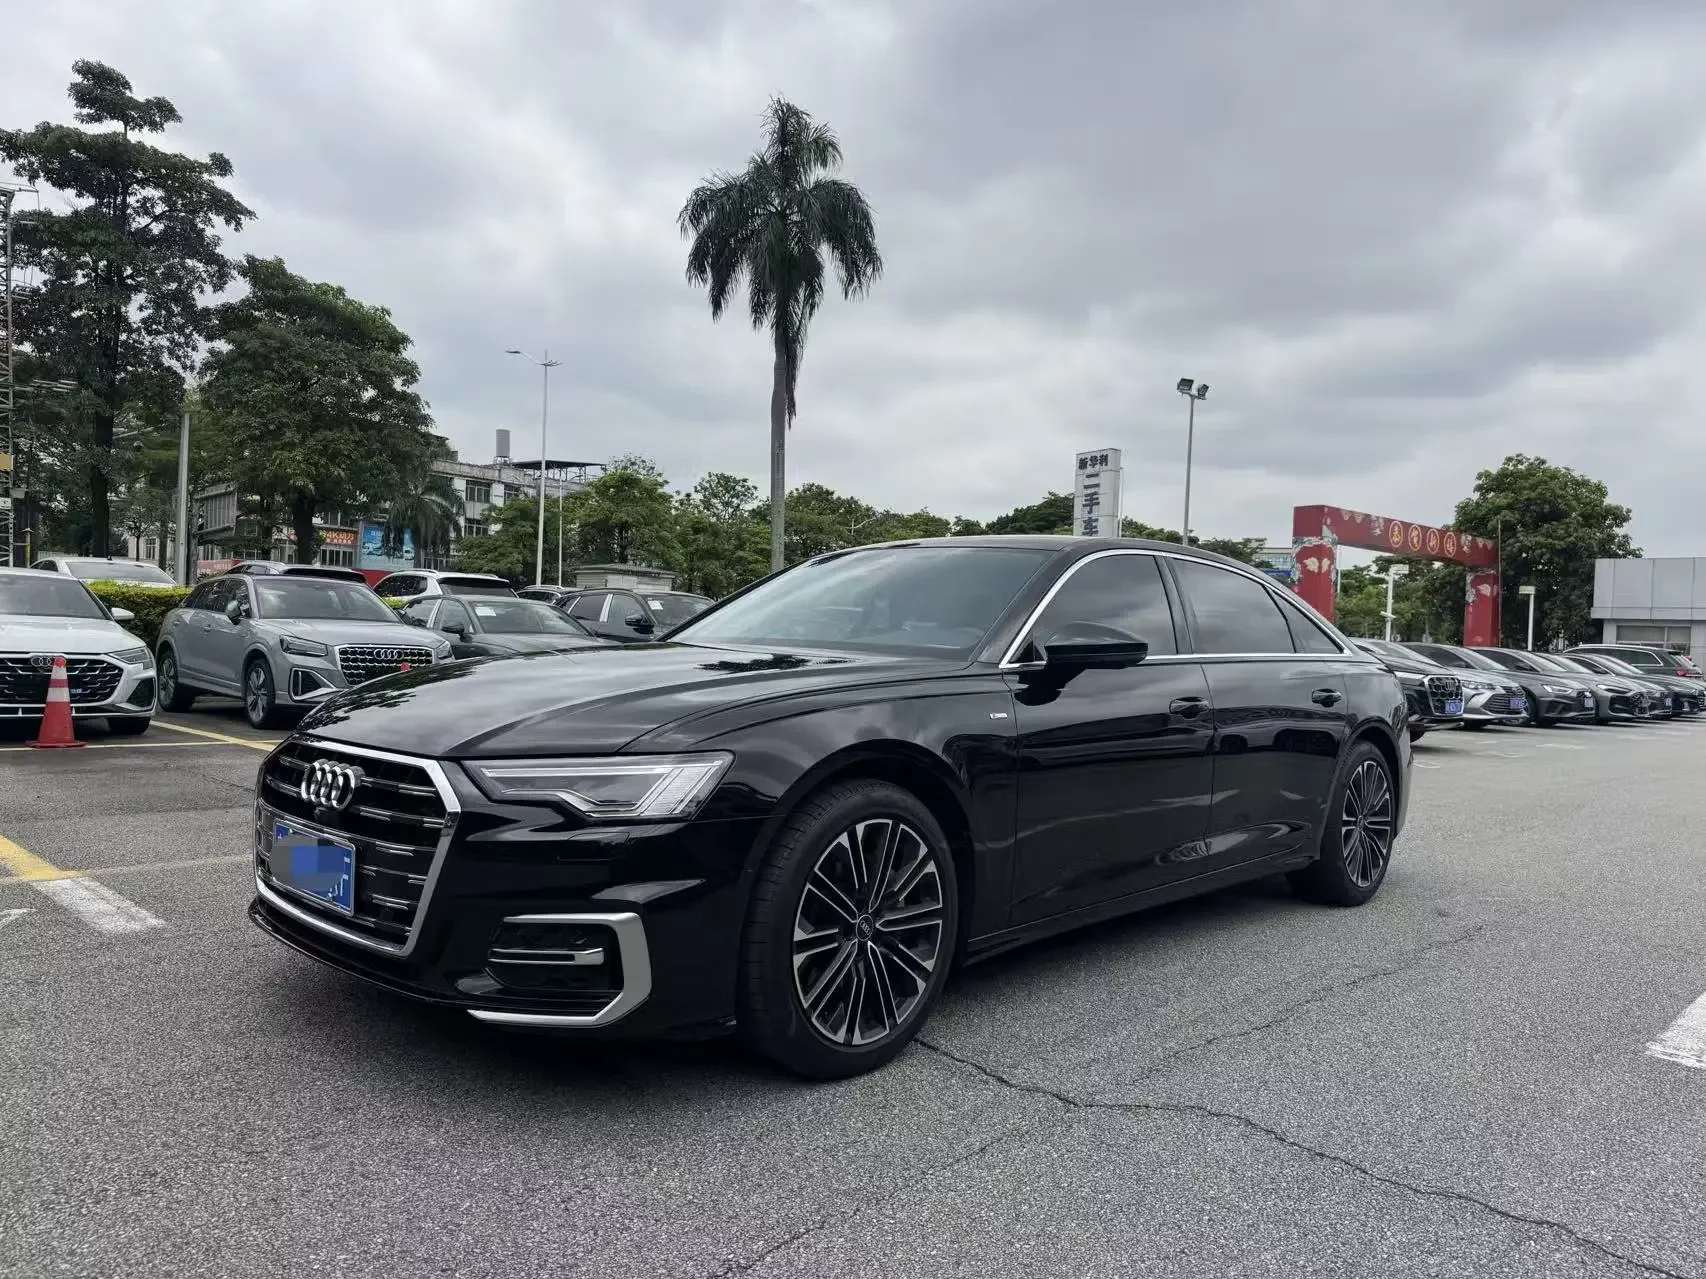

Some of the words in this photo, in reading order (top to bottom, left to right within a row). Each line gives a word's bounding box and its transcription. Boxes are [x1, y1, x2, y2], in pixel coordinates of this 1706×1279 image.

[1078, 453, 1109, 470] 新华利
[1081, 472, 1101, 537] 二手车
